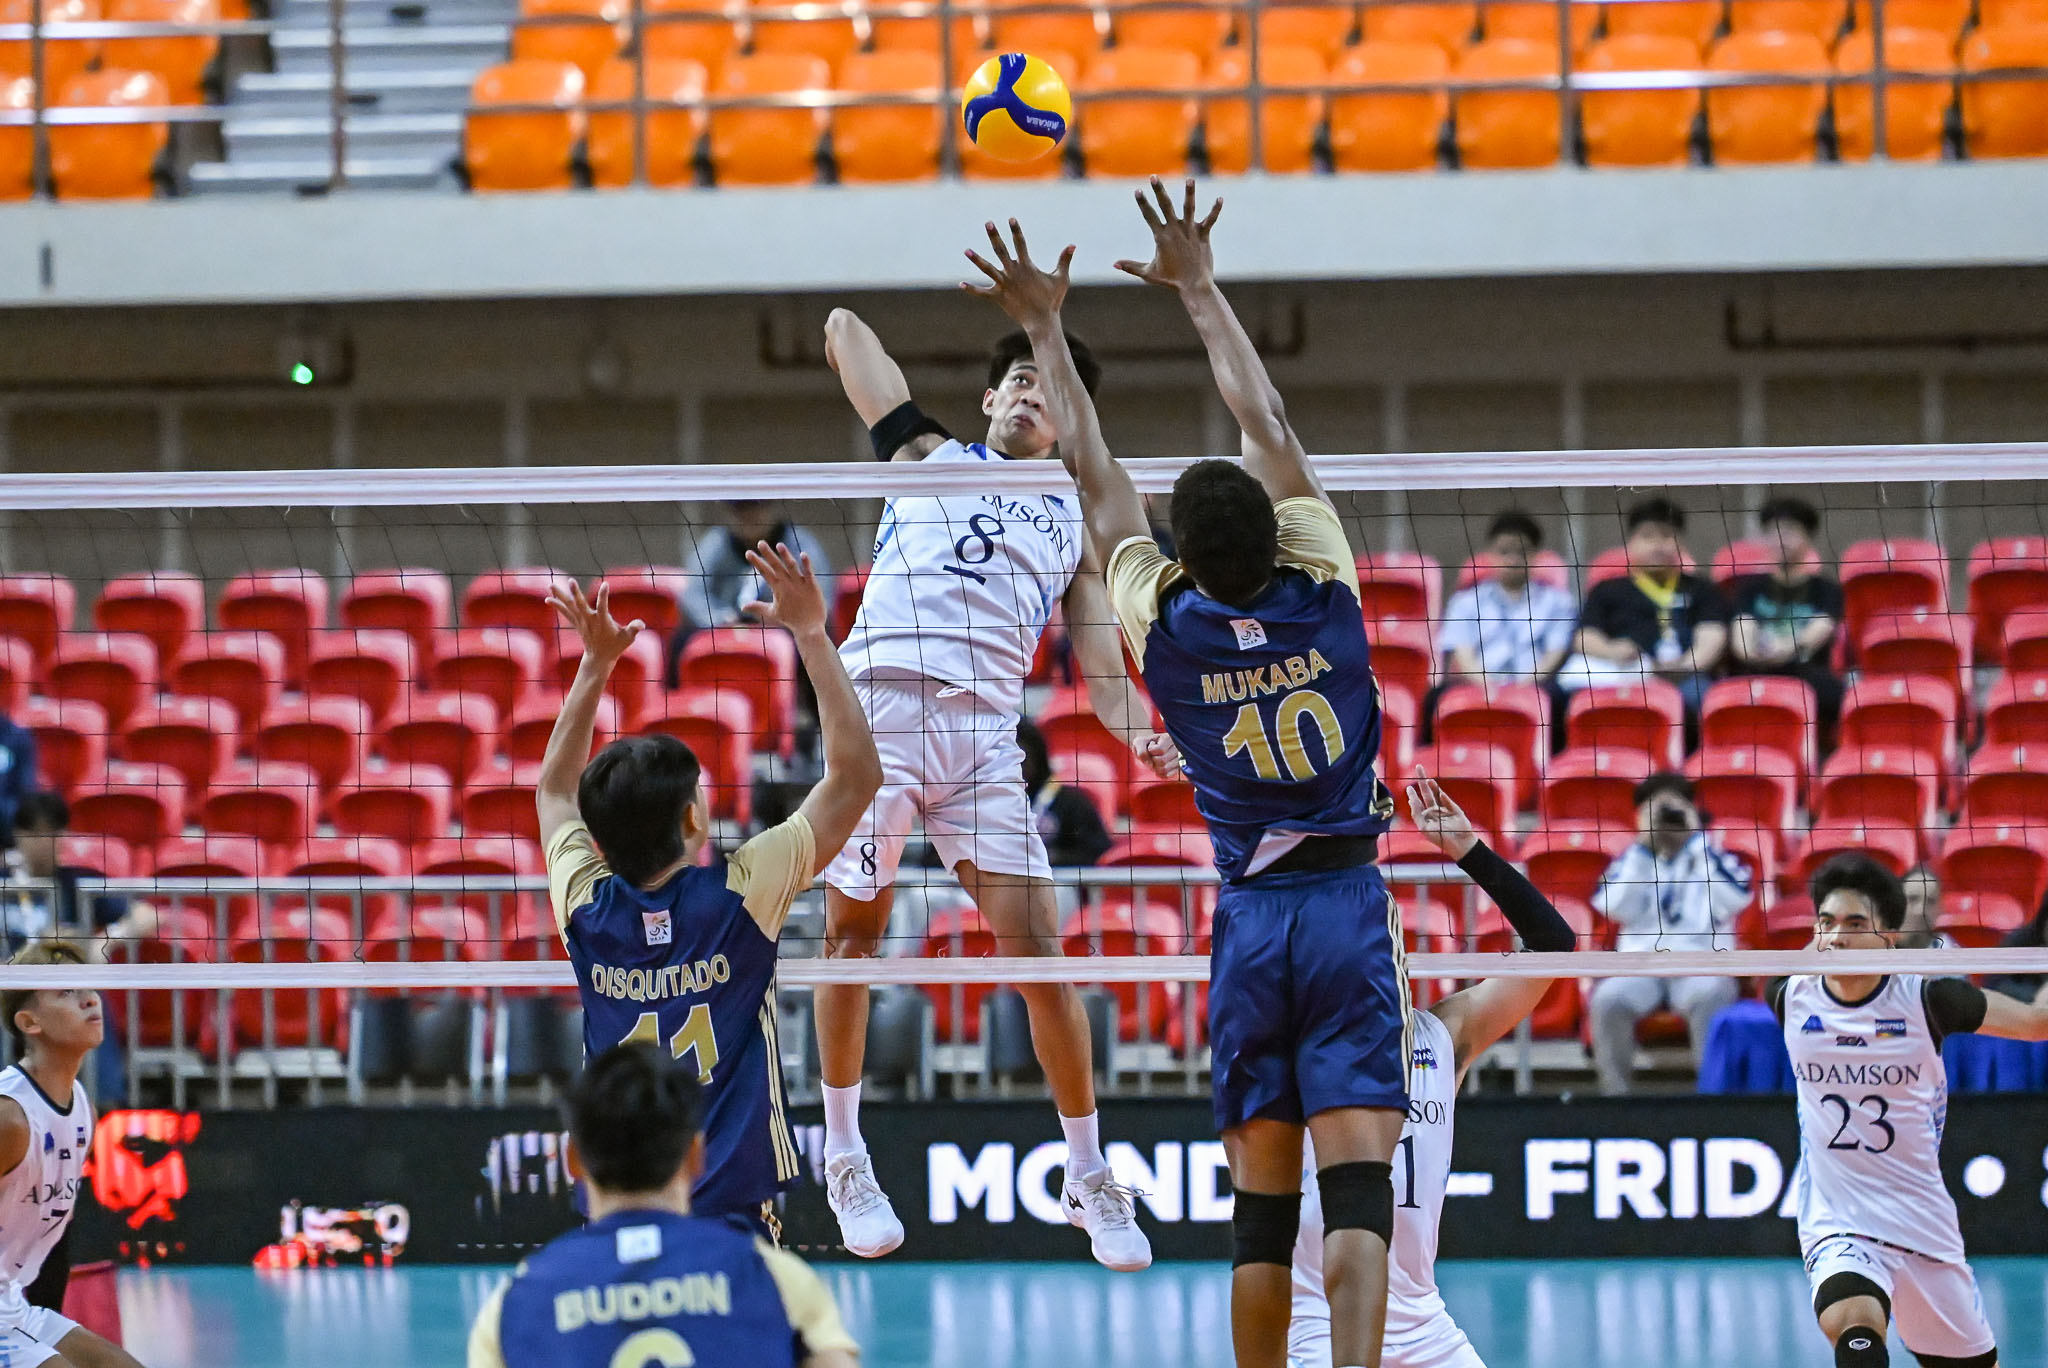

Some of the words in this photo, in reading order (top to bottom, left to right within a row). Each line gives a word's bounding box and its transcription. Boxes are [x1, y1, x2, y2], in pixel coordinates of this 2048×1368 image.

[1201, 648, 1332, 704] MUKABA
[1222, 689, 1346, 782] 10
[860, 842, 877, 876] 8
[592, 953, 731, 1003] DISQUITADO
[1796, 1062, 1922, 1086] ADAMSON
[1820, 1093, 1896, 1154] 23
[41, 1208, 69, 1239] 7
[553, 1271, 732, 1334] BUDDIN
